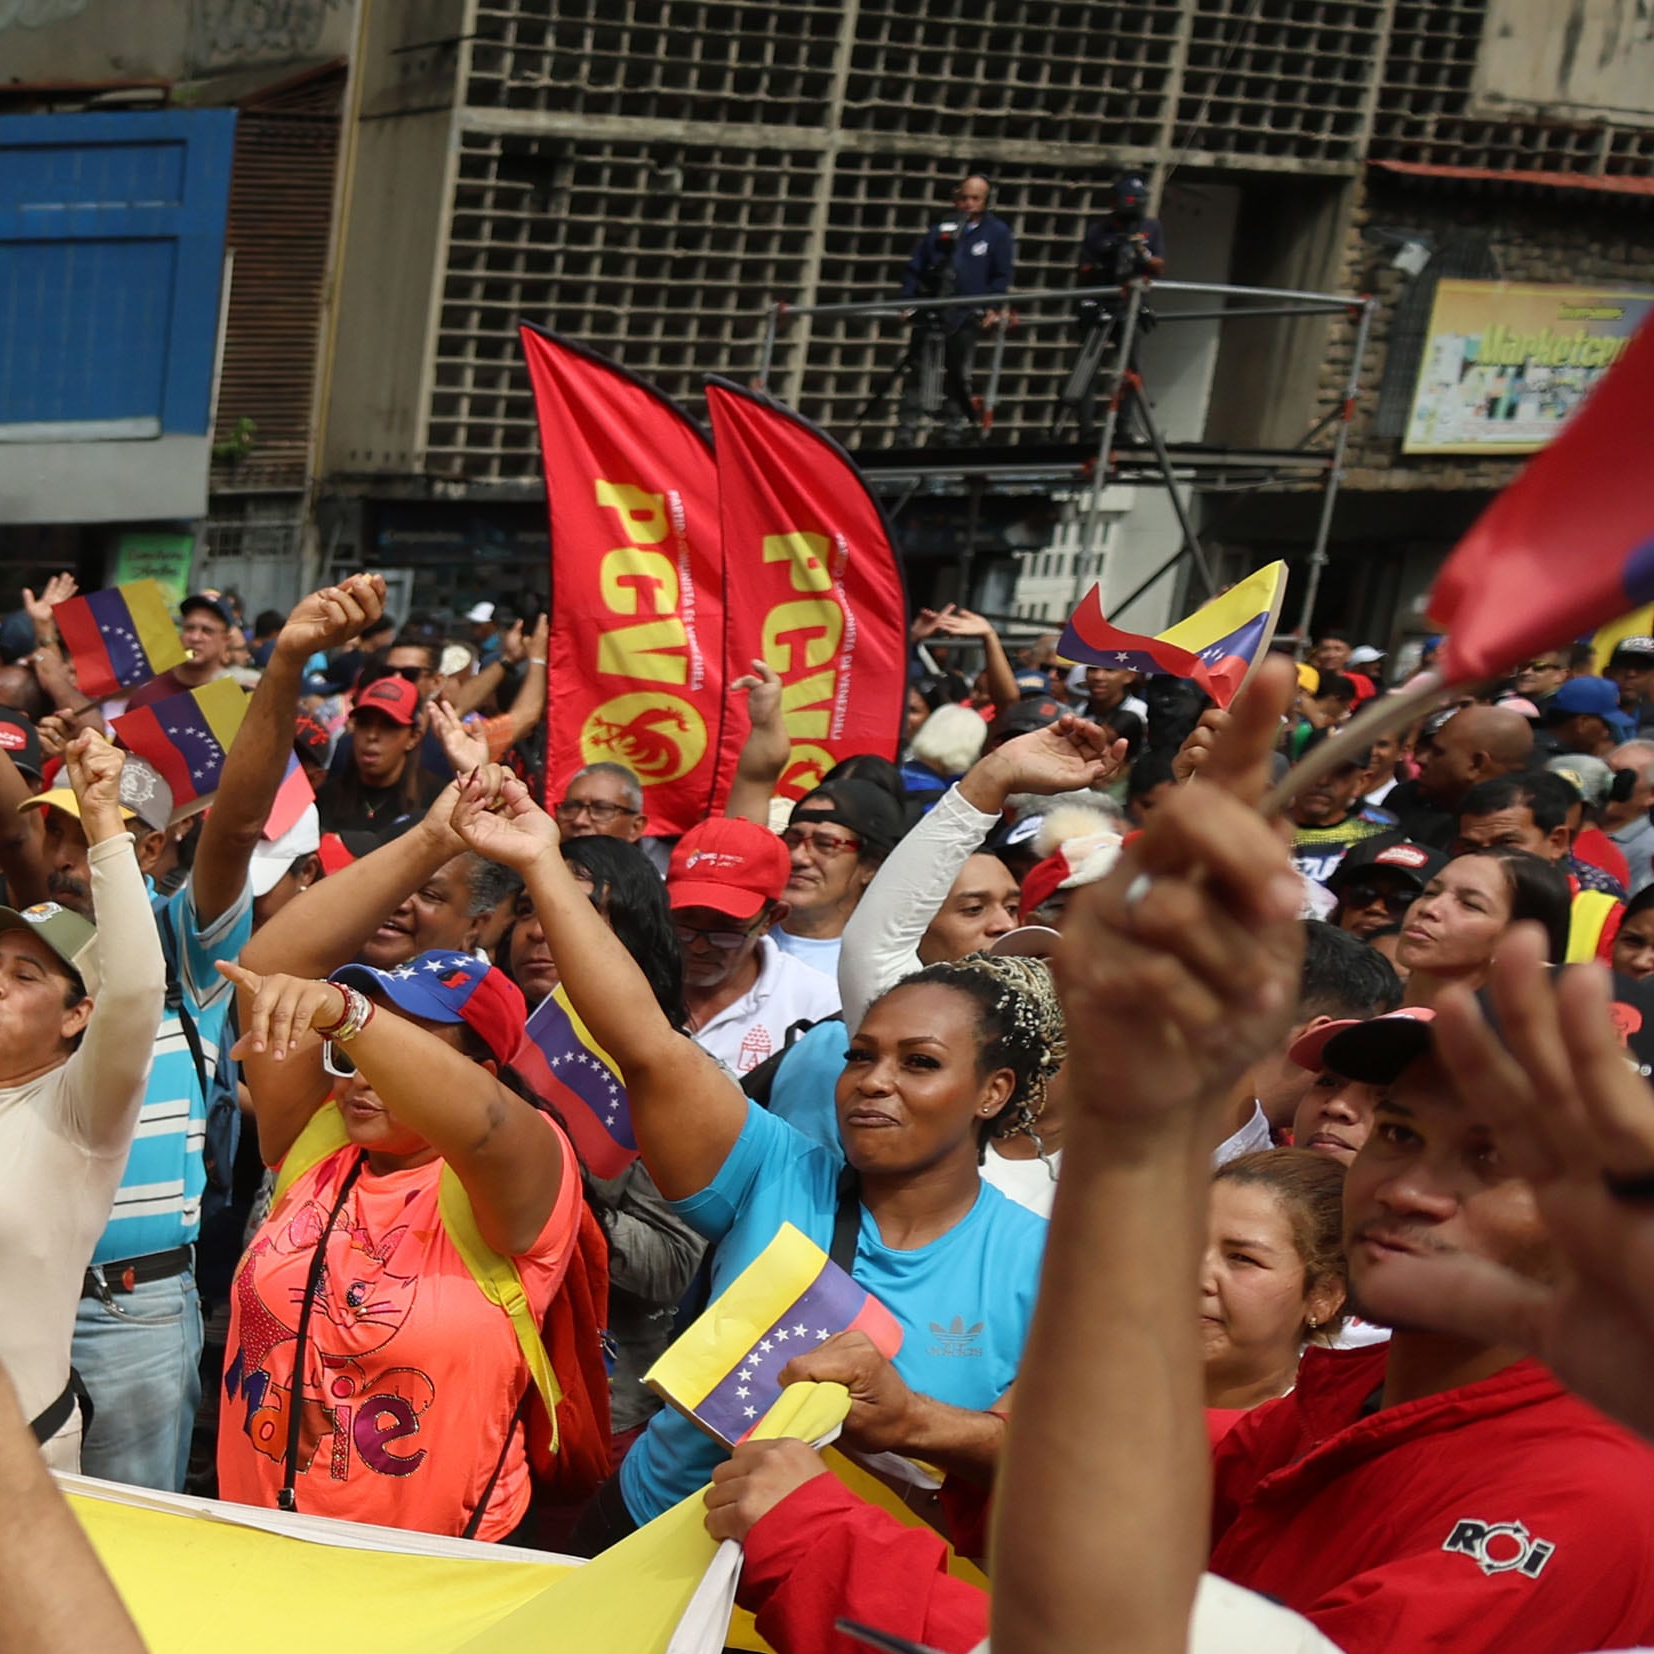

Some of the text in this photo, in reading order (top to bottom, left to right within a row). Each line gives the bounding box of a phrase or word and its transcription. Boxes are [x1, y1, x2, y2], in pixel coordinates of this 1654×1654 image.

[595, 479, 688, 686] PCV
[762, 531, 843, 740] PCV
[830, 673, 852, 741] VENEZUEL
